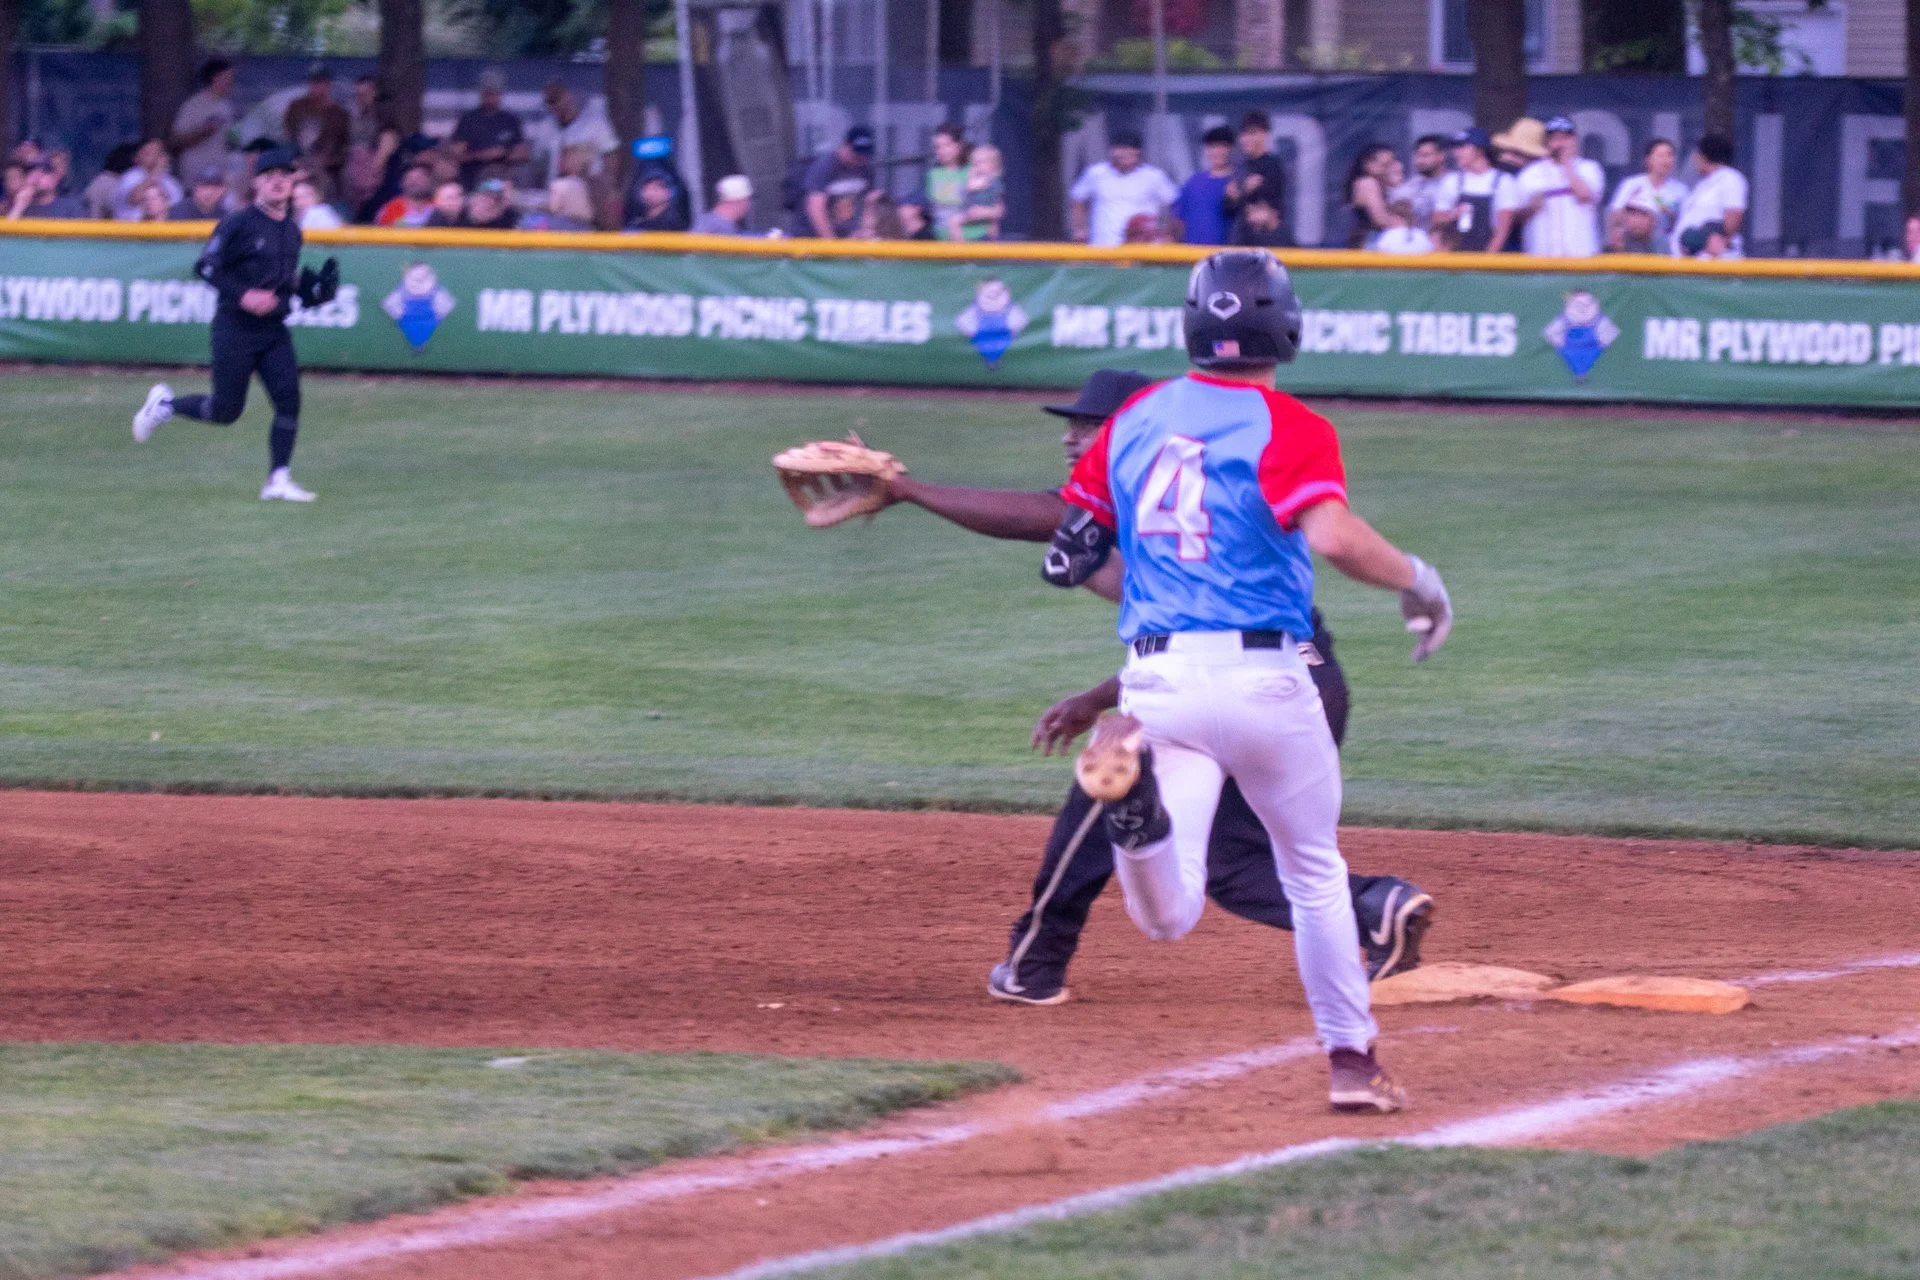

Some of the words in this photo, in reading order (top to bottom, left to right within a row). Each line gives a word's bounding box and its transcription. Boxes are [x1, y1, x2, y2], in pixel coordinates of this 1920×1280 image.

[477, 288, 534, 332] MR
[538, 289, 694, 336] PLYWOOD
[699, 296, 808, 341] PICNIC
[813, 299, 932, 344] TABLES
[1052, 304, 1110, 347] MR
[1300, 309, 1391, 354] ICNIC
[1398, 311, 1517, 357] TABLES
[1644, 317, 1701, 360] MR
[1707, 319, 1873, 364] PLYWOOD
[1137, 435, 1211, 561] 4
